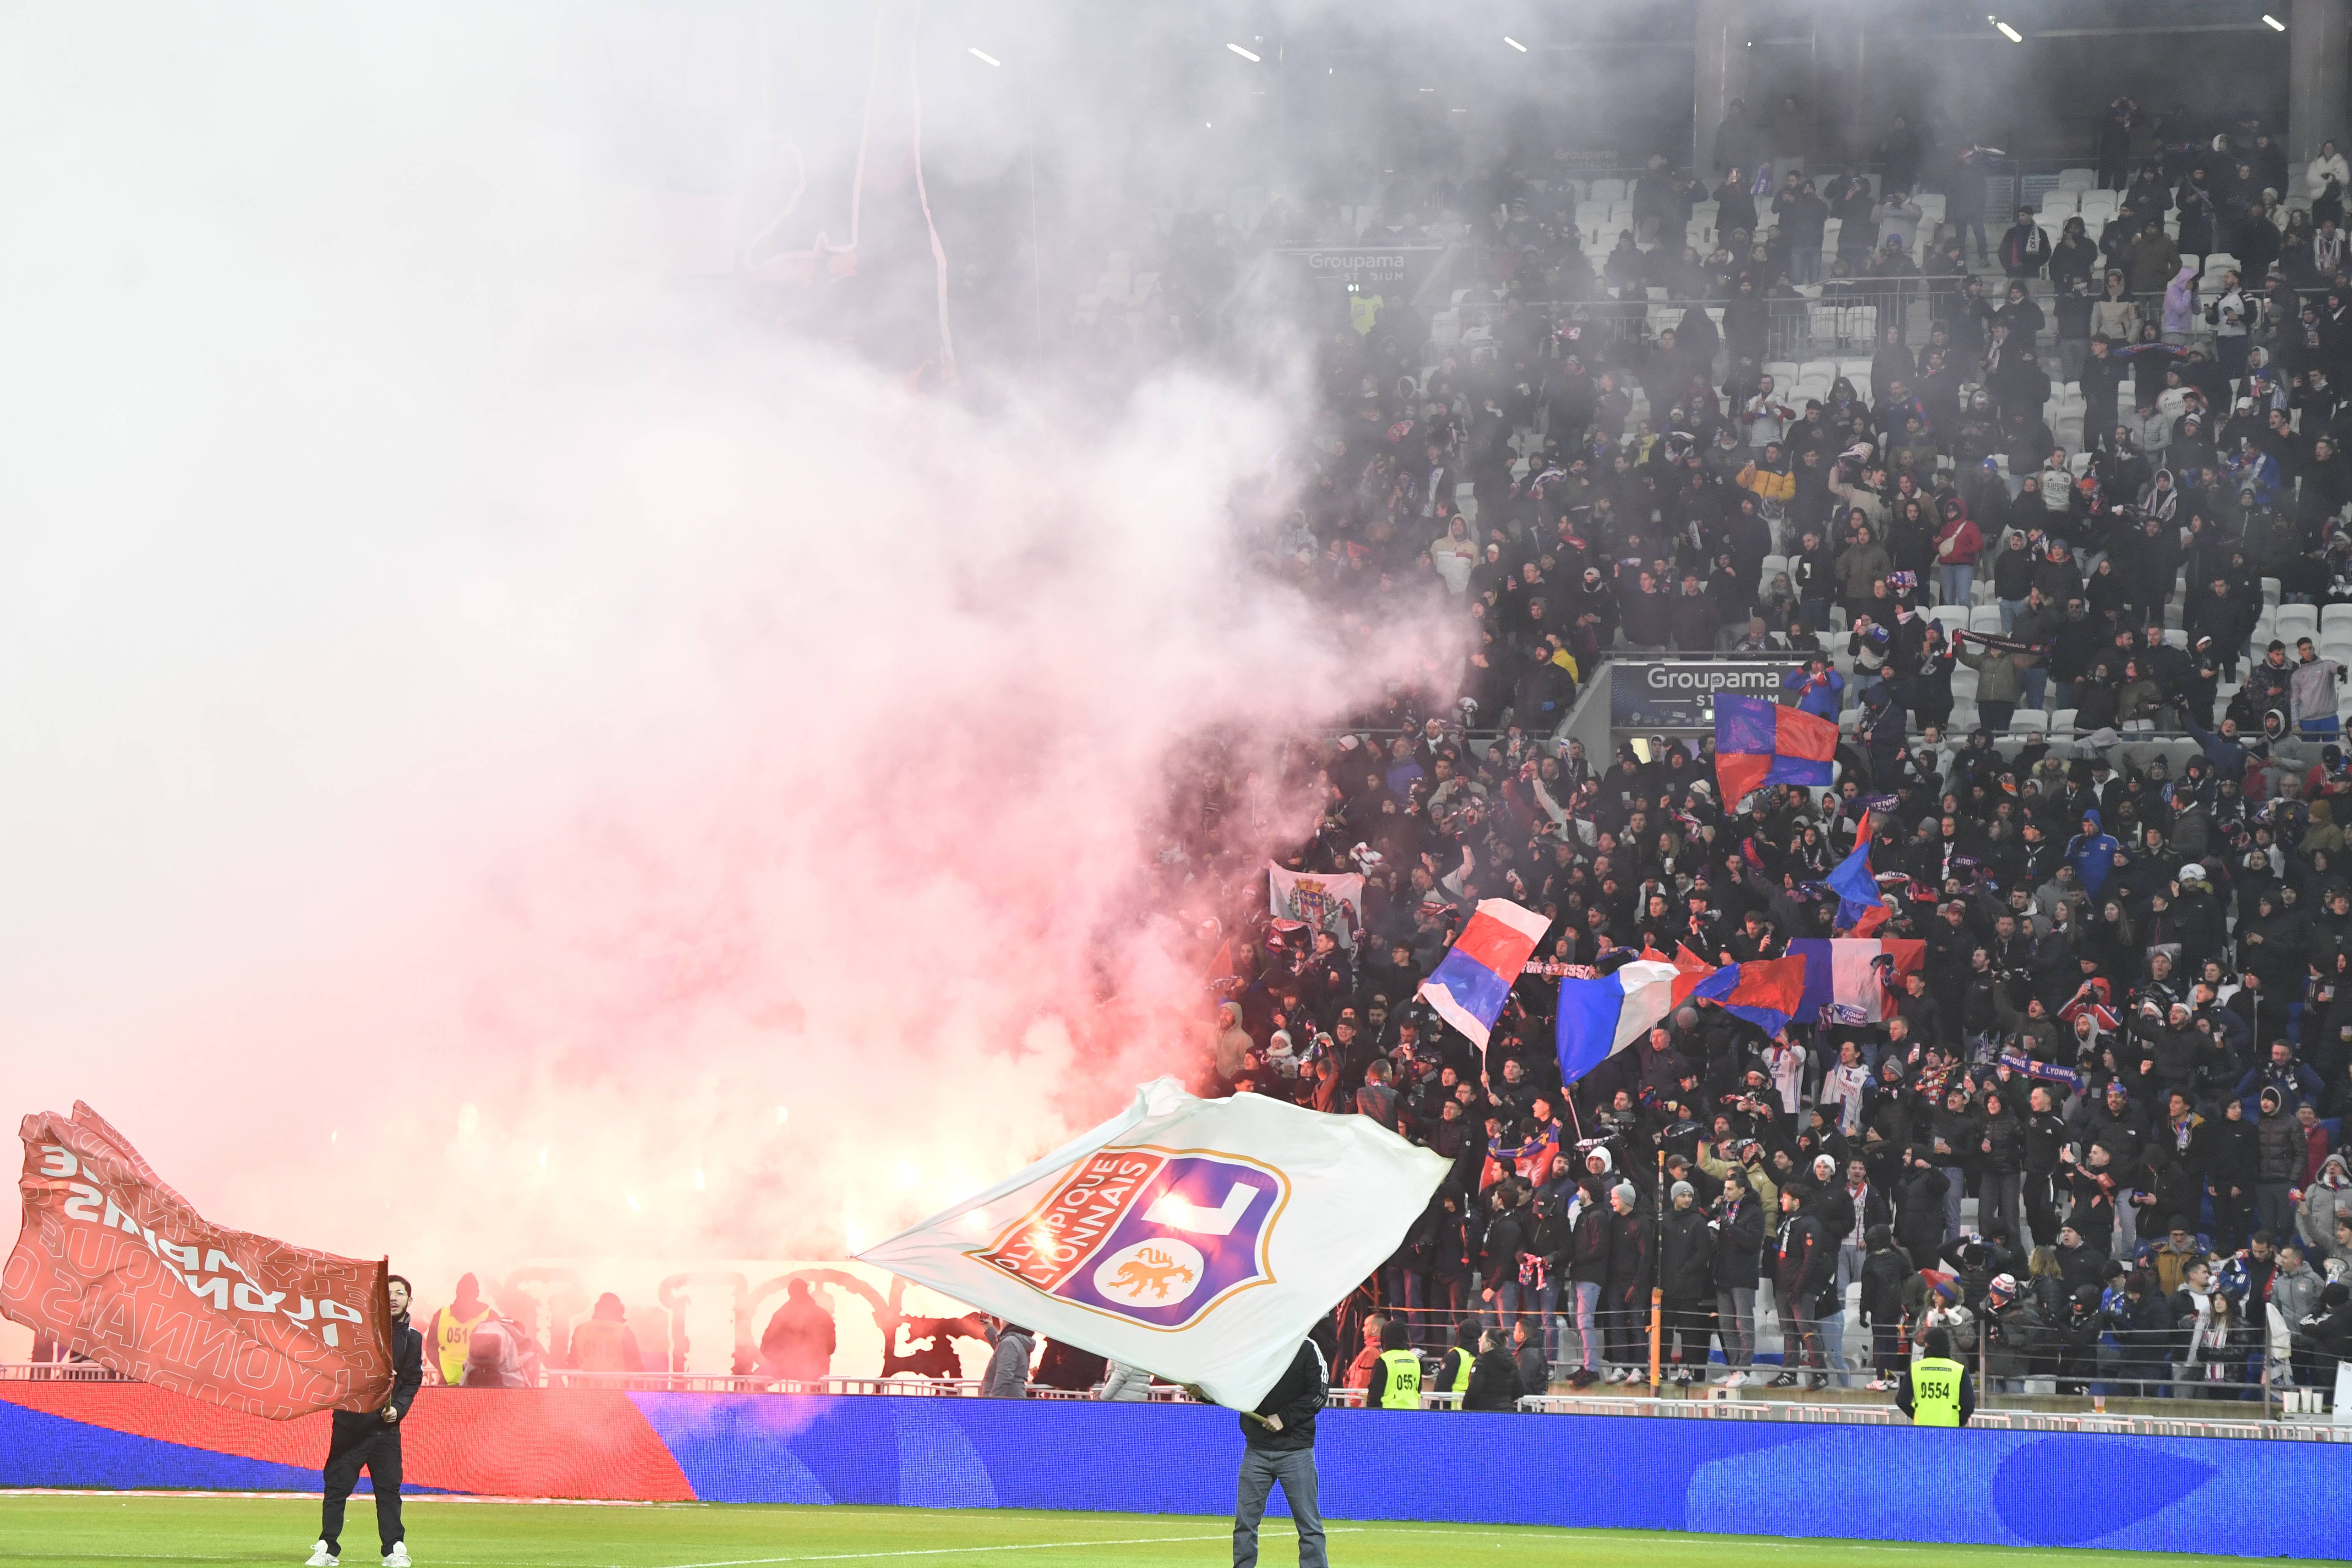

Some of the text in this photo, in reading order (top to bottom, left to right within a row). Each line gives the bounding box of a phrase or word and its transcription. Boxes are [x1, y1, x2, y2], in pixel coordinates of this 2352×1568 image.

[1309, 253, 1403, 271] Groupama
[1345, 272, 1403, 281] STDIUM
[1648, 667, 1780, 693] Groupama
[1021, 1160, 1148, 1284] LYONNAIS
[1921, 1382, 1950, 1399] 0554
